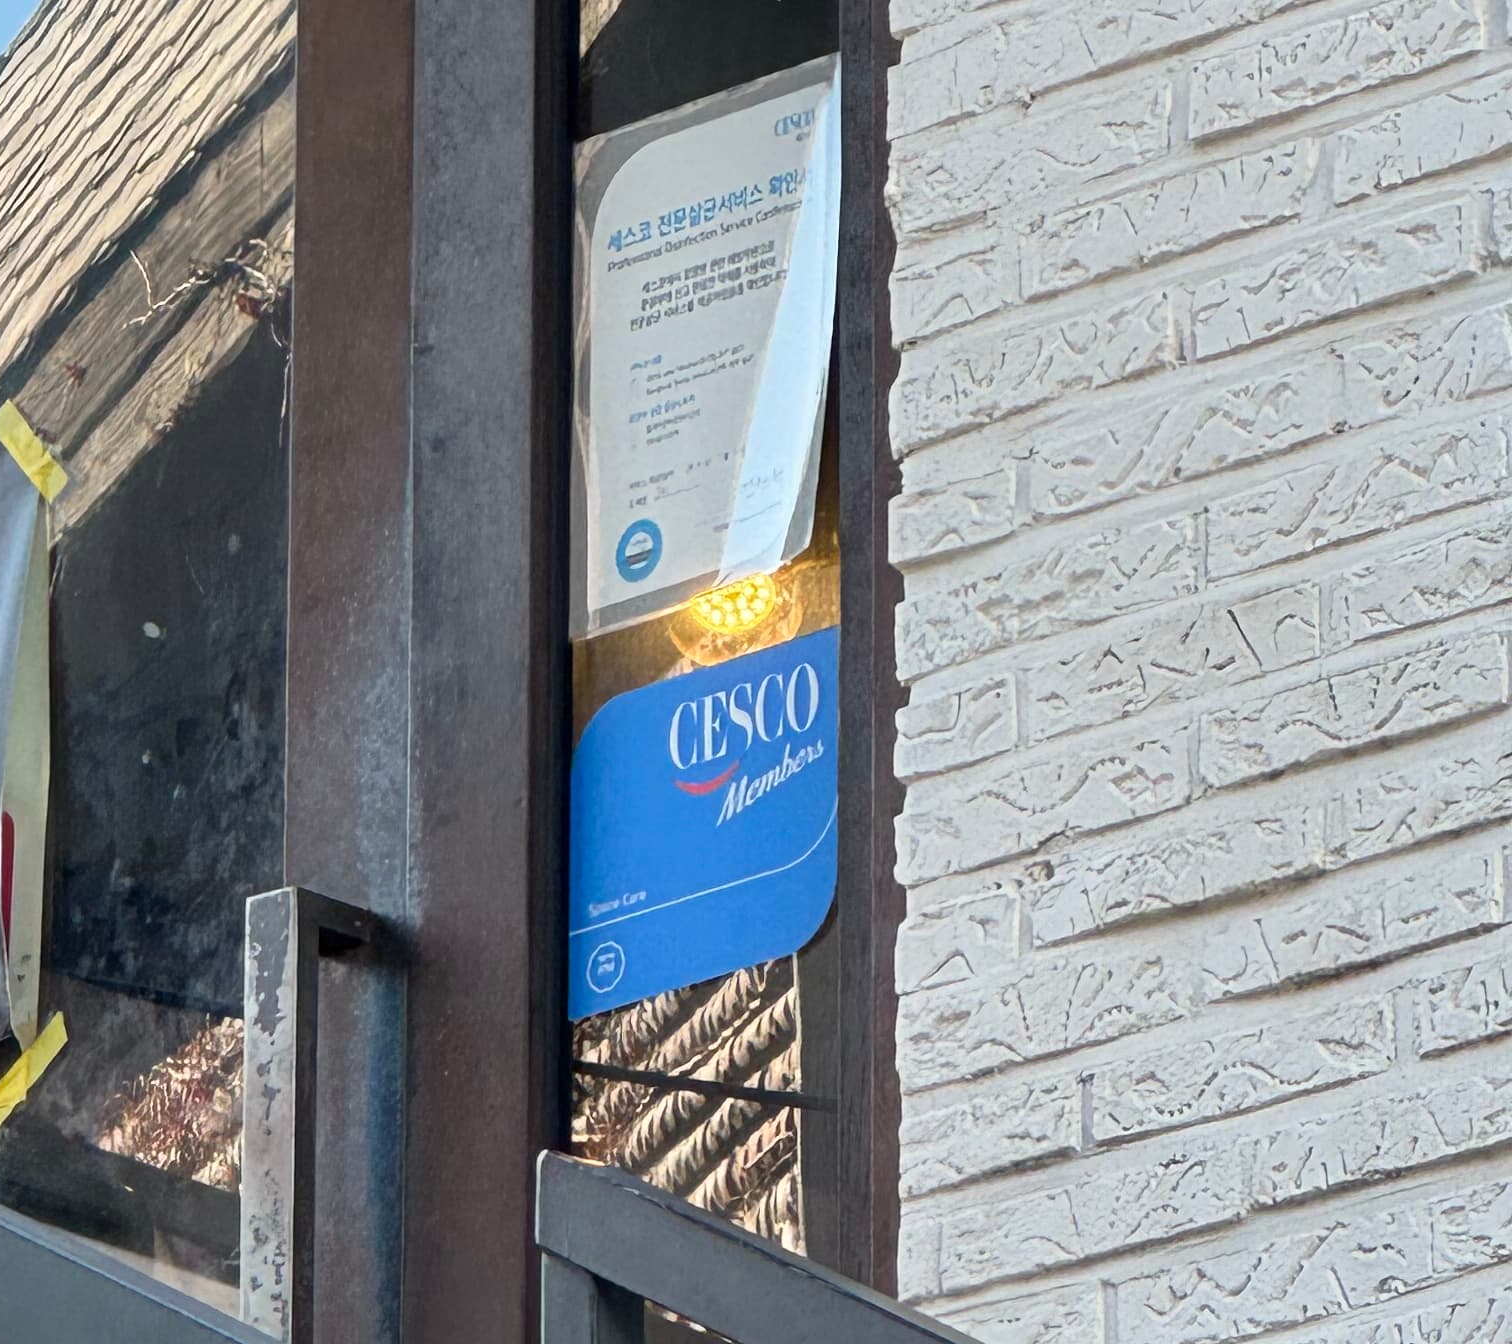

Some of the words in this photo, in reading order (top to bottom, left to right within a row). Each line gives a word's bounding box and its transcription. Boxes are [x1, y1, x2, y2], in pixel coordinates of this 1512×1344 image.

[669, 662, 820, 770] CESCO
[715, 738, 825, 828] Members
[622, 890, 647, 906] Care
